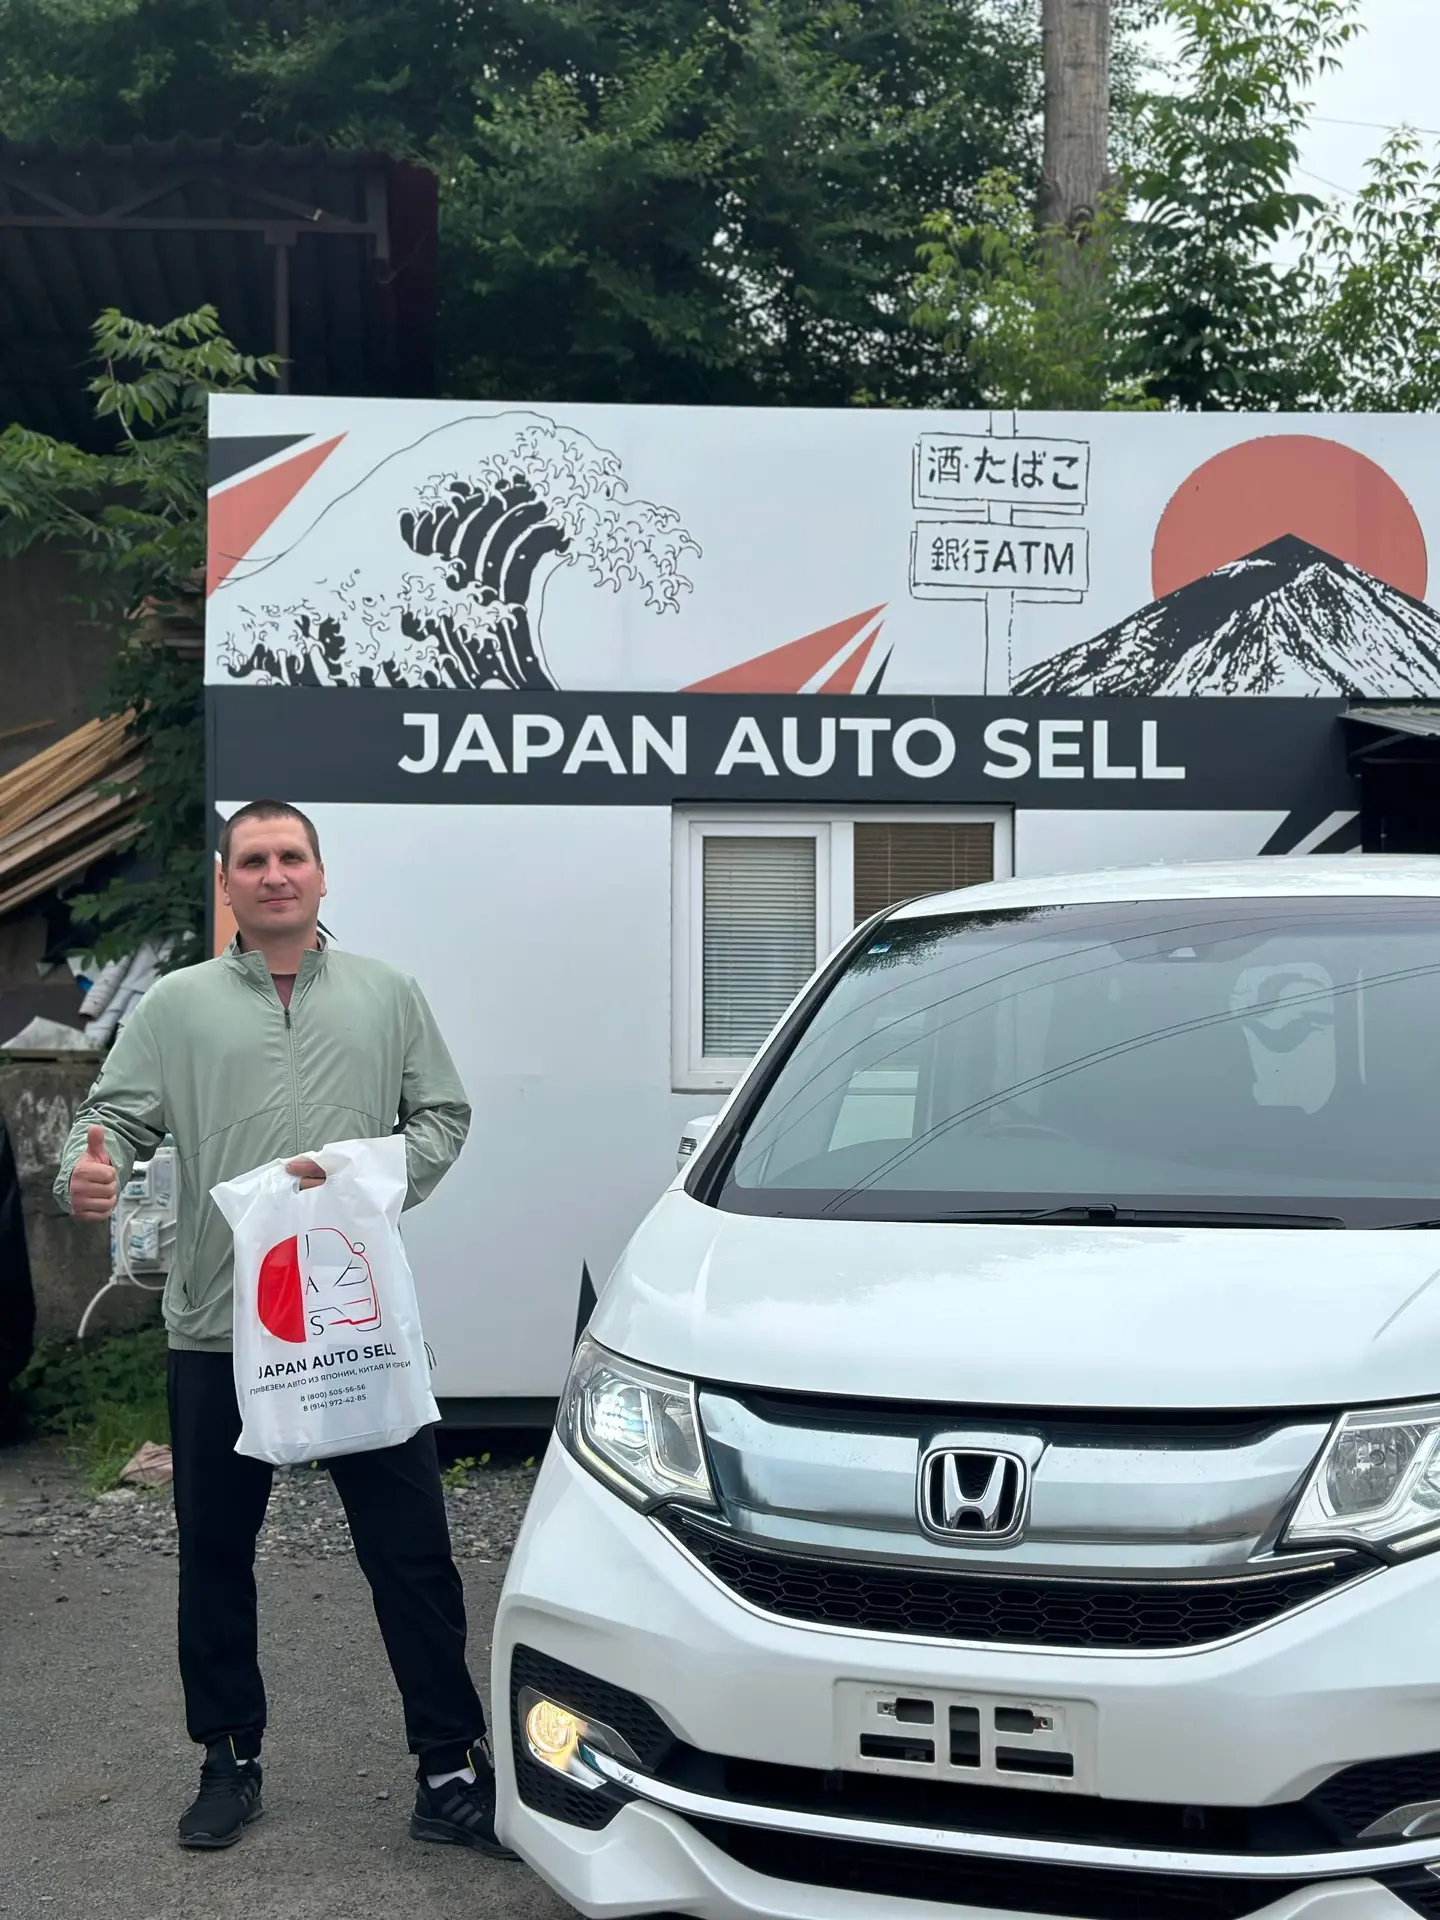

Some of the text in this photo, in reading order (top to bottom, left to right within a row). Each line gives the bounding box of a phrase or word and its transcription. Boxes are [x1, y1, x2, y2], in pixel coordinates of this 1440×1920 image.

[398, 713, 1186, 780] JAPAN AUTO SELL
[258, 1343, 396, 1379] JAPAN AUTO SELL
[287, 1378, 307, 1389] АВТО
[308, 1376, 319, 1384] ИЗ
[320, 1369, 358, 1381] ЯПОНИИ,
[358, 1363, 384, 1374] КИТАЯ
[307, 1391, 327, 1402] (800)
[328, 1384, 366, 1397] 505-56-56
[310, 1401, 328, 1411] (914)
[329, 1394, 367, 1407] 972-42-85
